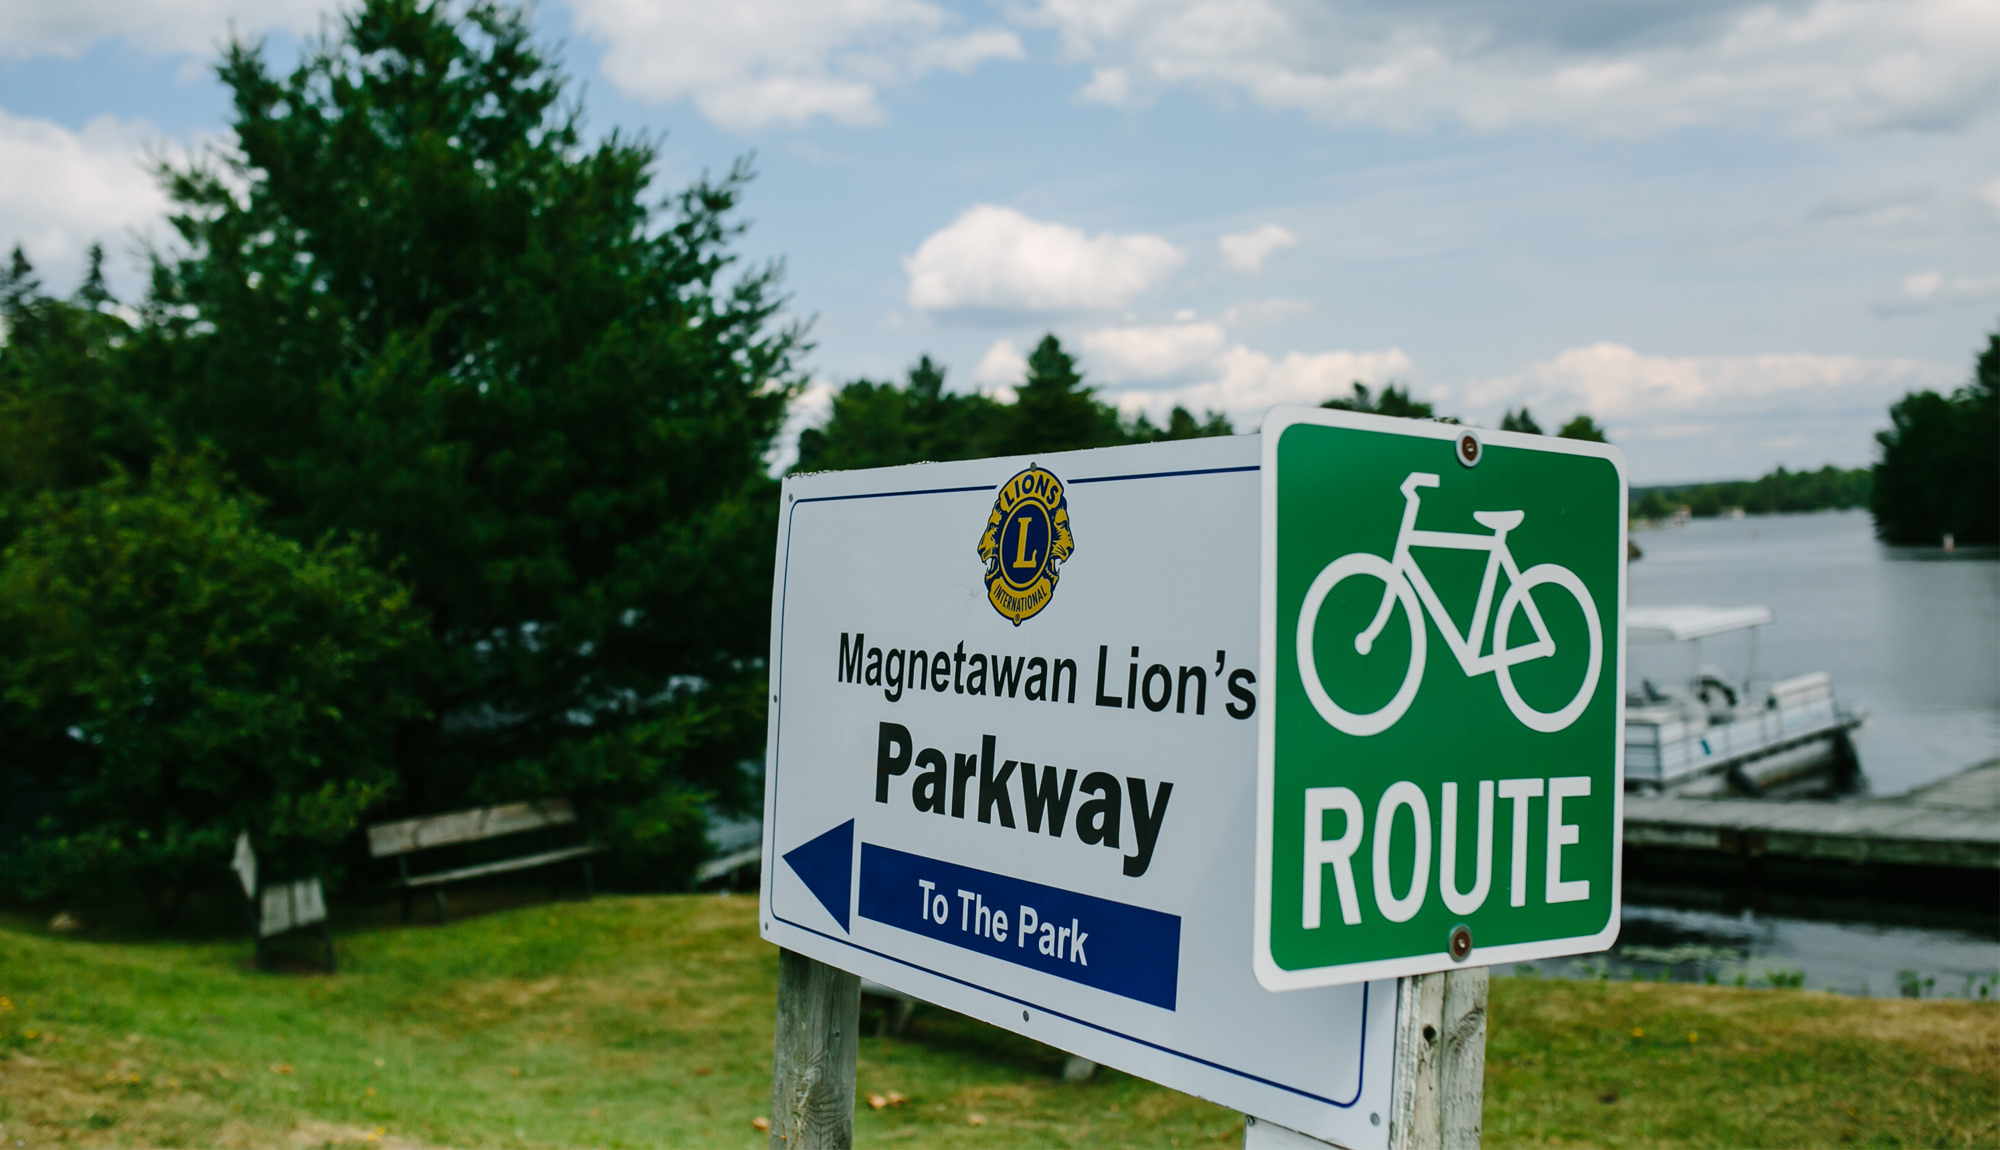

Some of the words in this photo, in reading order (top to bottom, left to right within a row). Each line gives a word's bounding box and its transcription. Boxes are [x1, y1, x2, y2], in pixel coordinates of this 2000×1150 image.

[1003, 474, 1059, 507] LIONS
[993, 585, 1048, 613] INTERNATIONAL
[837, 632, 1078, 704] Magnetawan
[1095, 644, 1257, 720] Lion's
[875, 721, 1174, 878] Parkway
[1302, 776, 1592, 930] ROUTE
[918, 878, 949, 925] To
[957, 888, 1009, 943] The
[1018, 904, 1089, 967] Park
